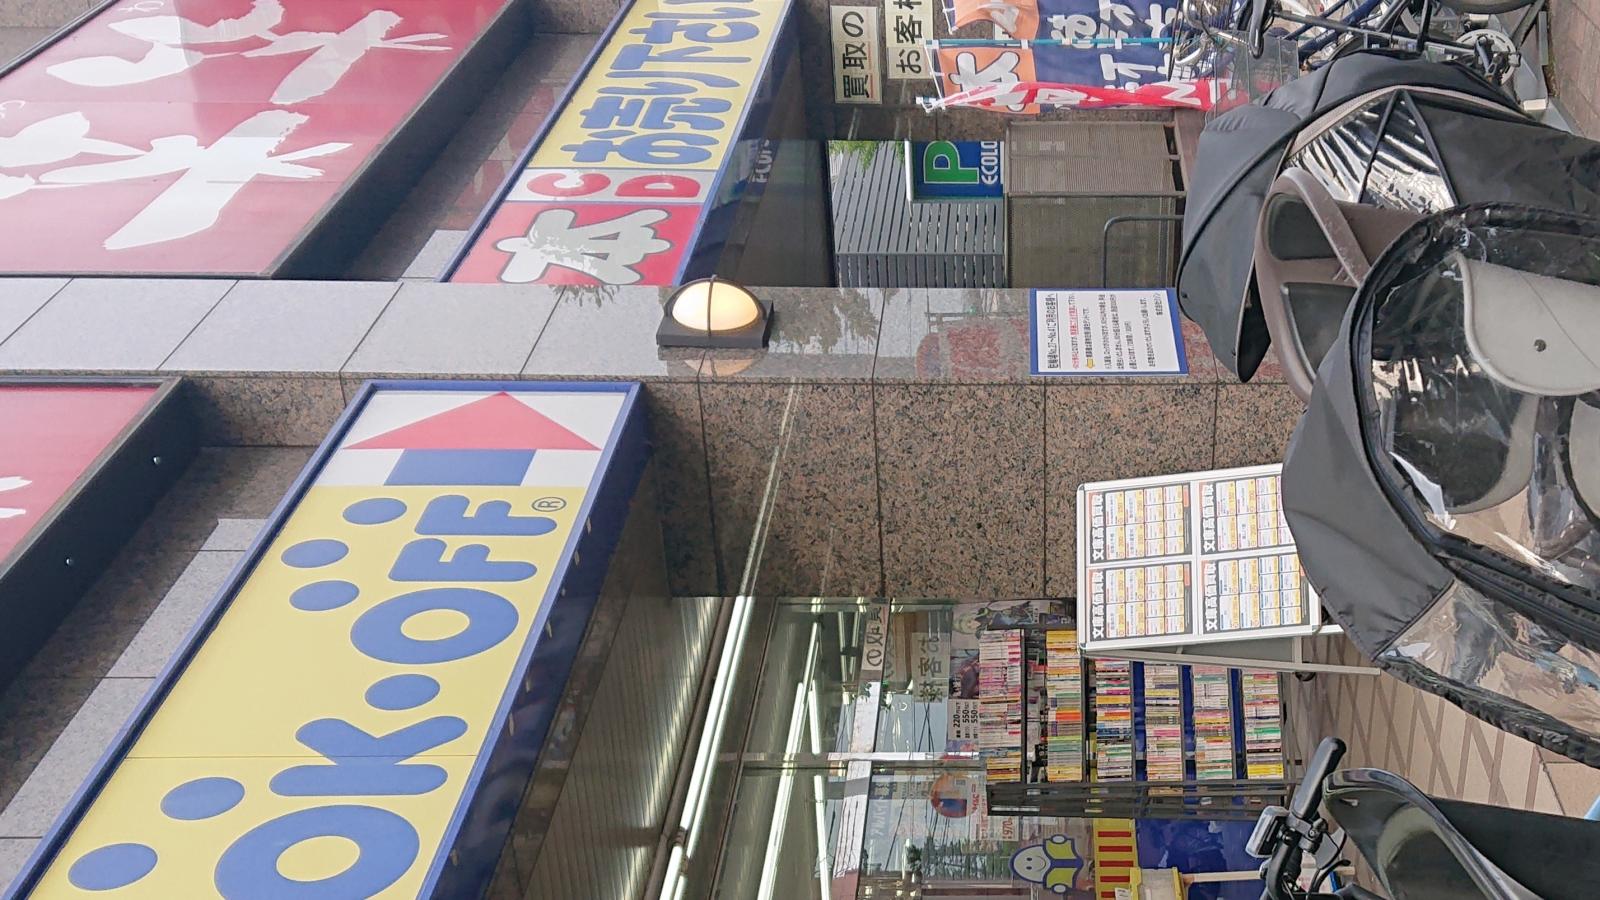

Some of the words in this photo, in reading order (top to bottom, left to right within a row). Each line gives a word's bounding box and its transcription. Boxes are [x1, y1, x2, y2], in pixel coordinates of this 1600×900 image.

[559, 0, 760, 165] お売り下さい
[841, 11, 870, 98] 買取の
[923, 140, 979, 184] P
[496, 208, 673, 286] 本
[1092, 571, 1104, 638] 文庫高価買取
